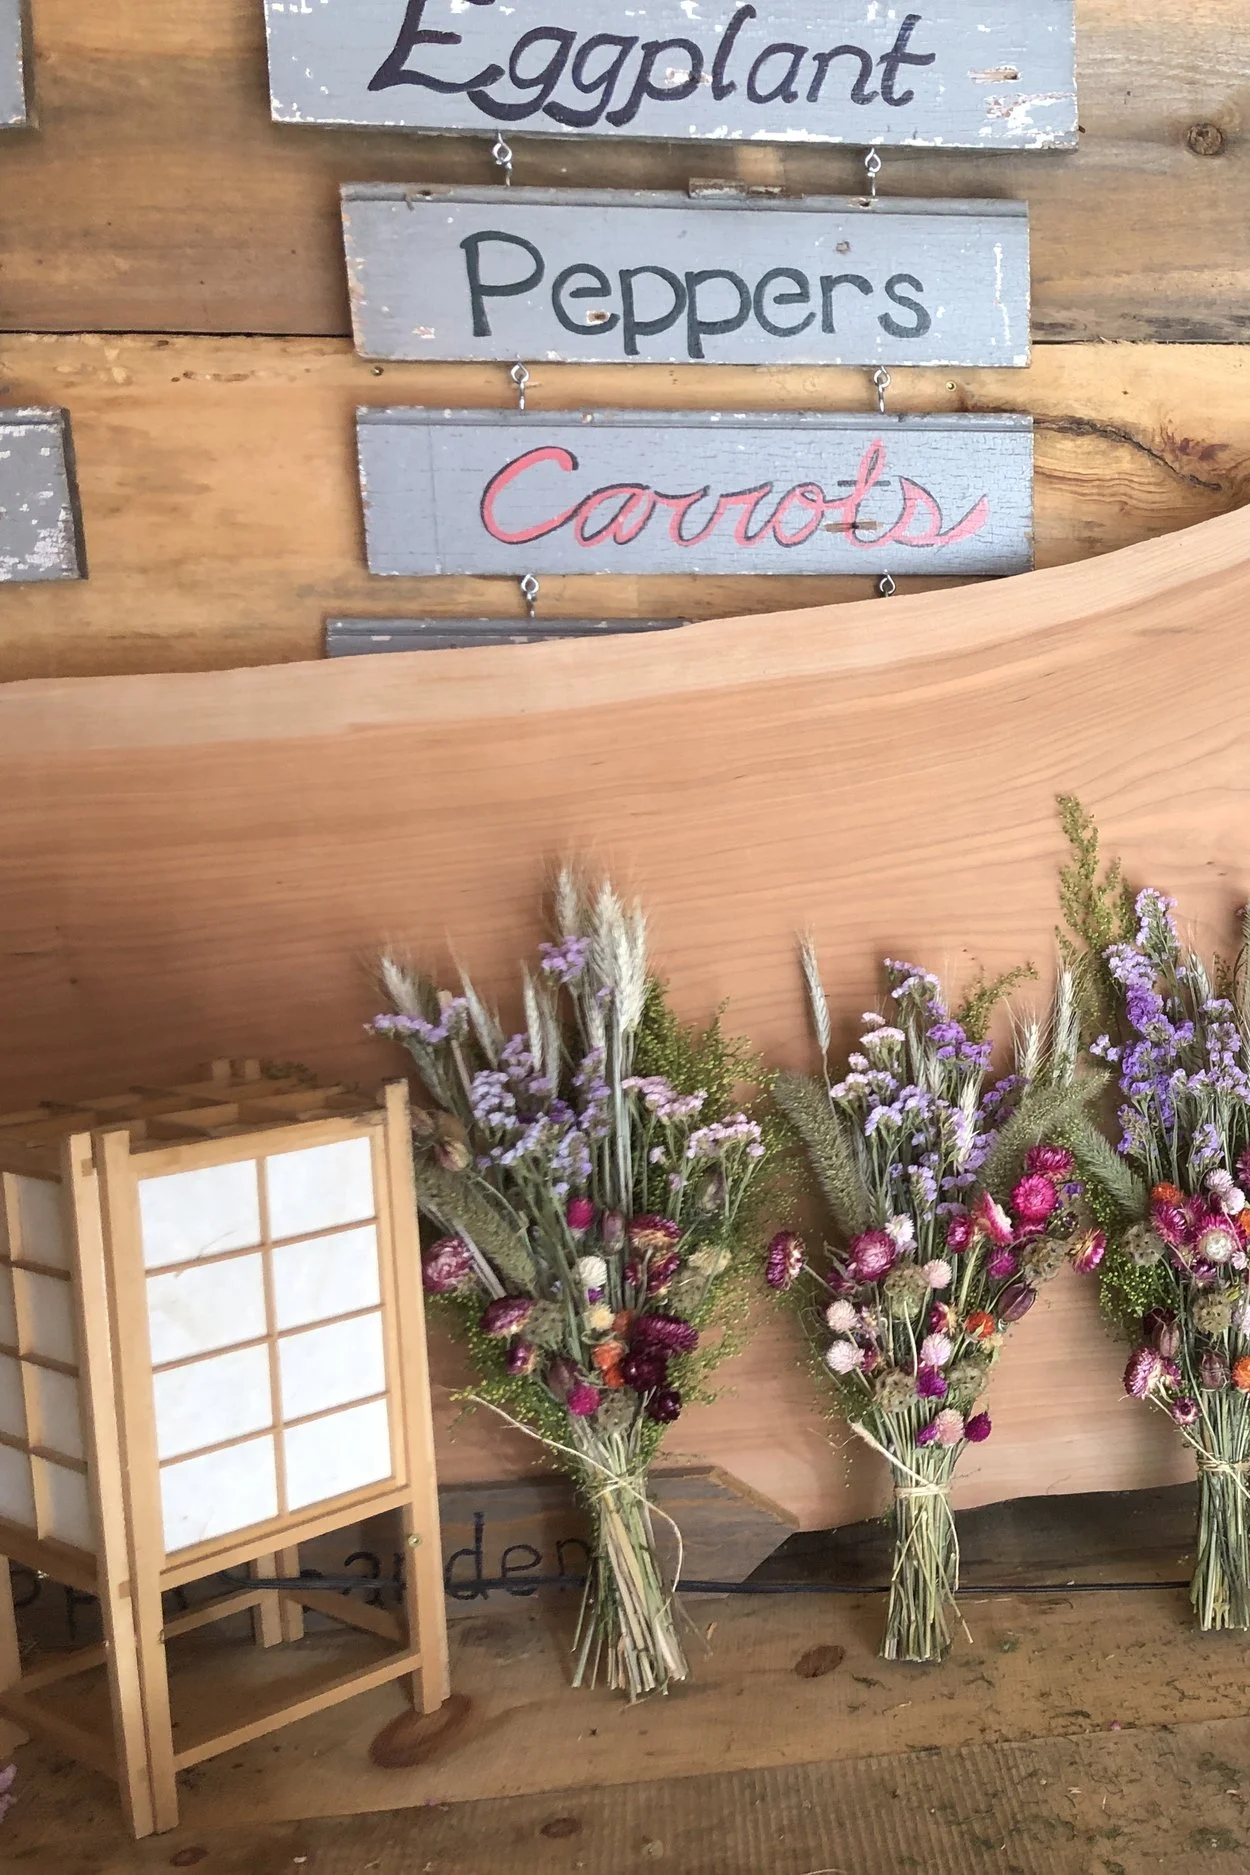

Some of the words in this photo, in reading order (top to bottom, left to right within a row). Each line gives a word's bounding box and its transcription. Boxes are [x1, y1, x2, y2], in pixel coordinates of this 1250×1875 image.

[367, 0, 936, 128] Eggplant
[459, 229, 932, 360] Peppers
[479, 437, 990, 549] Carrots
[298, 1510, 592, 1610] aden
